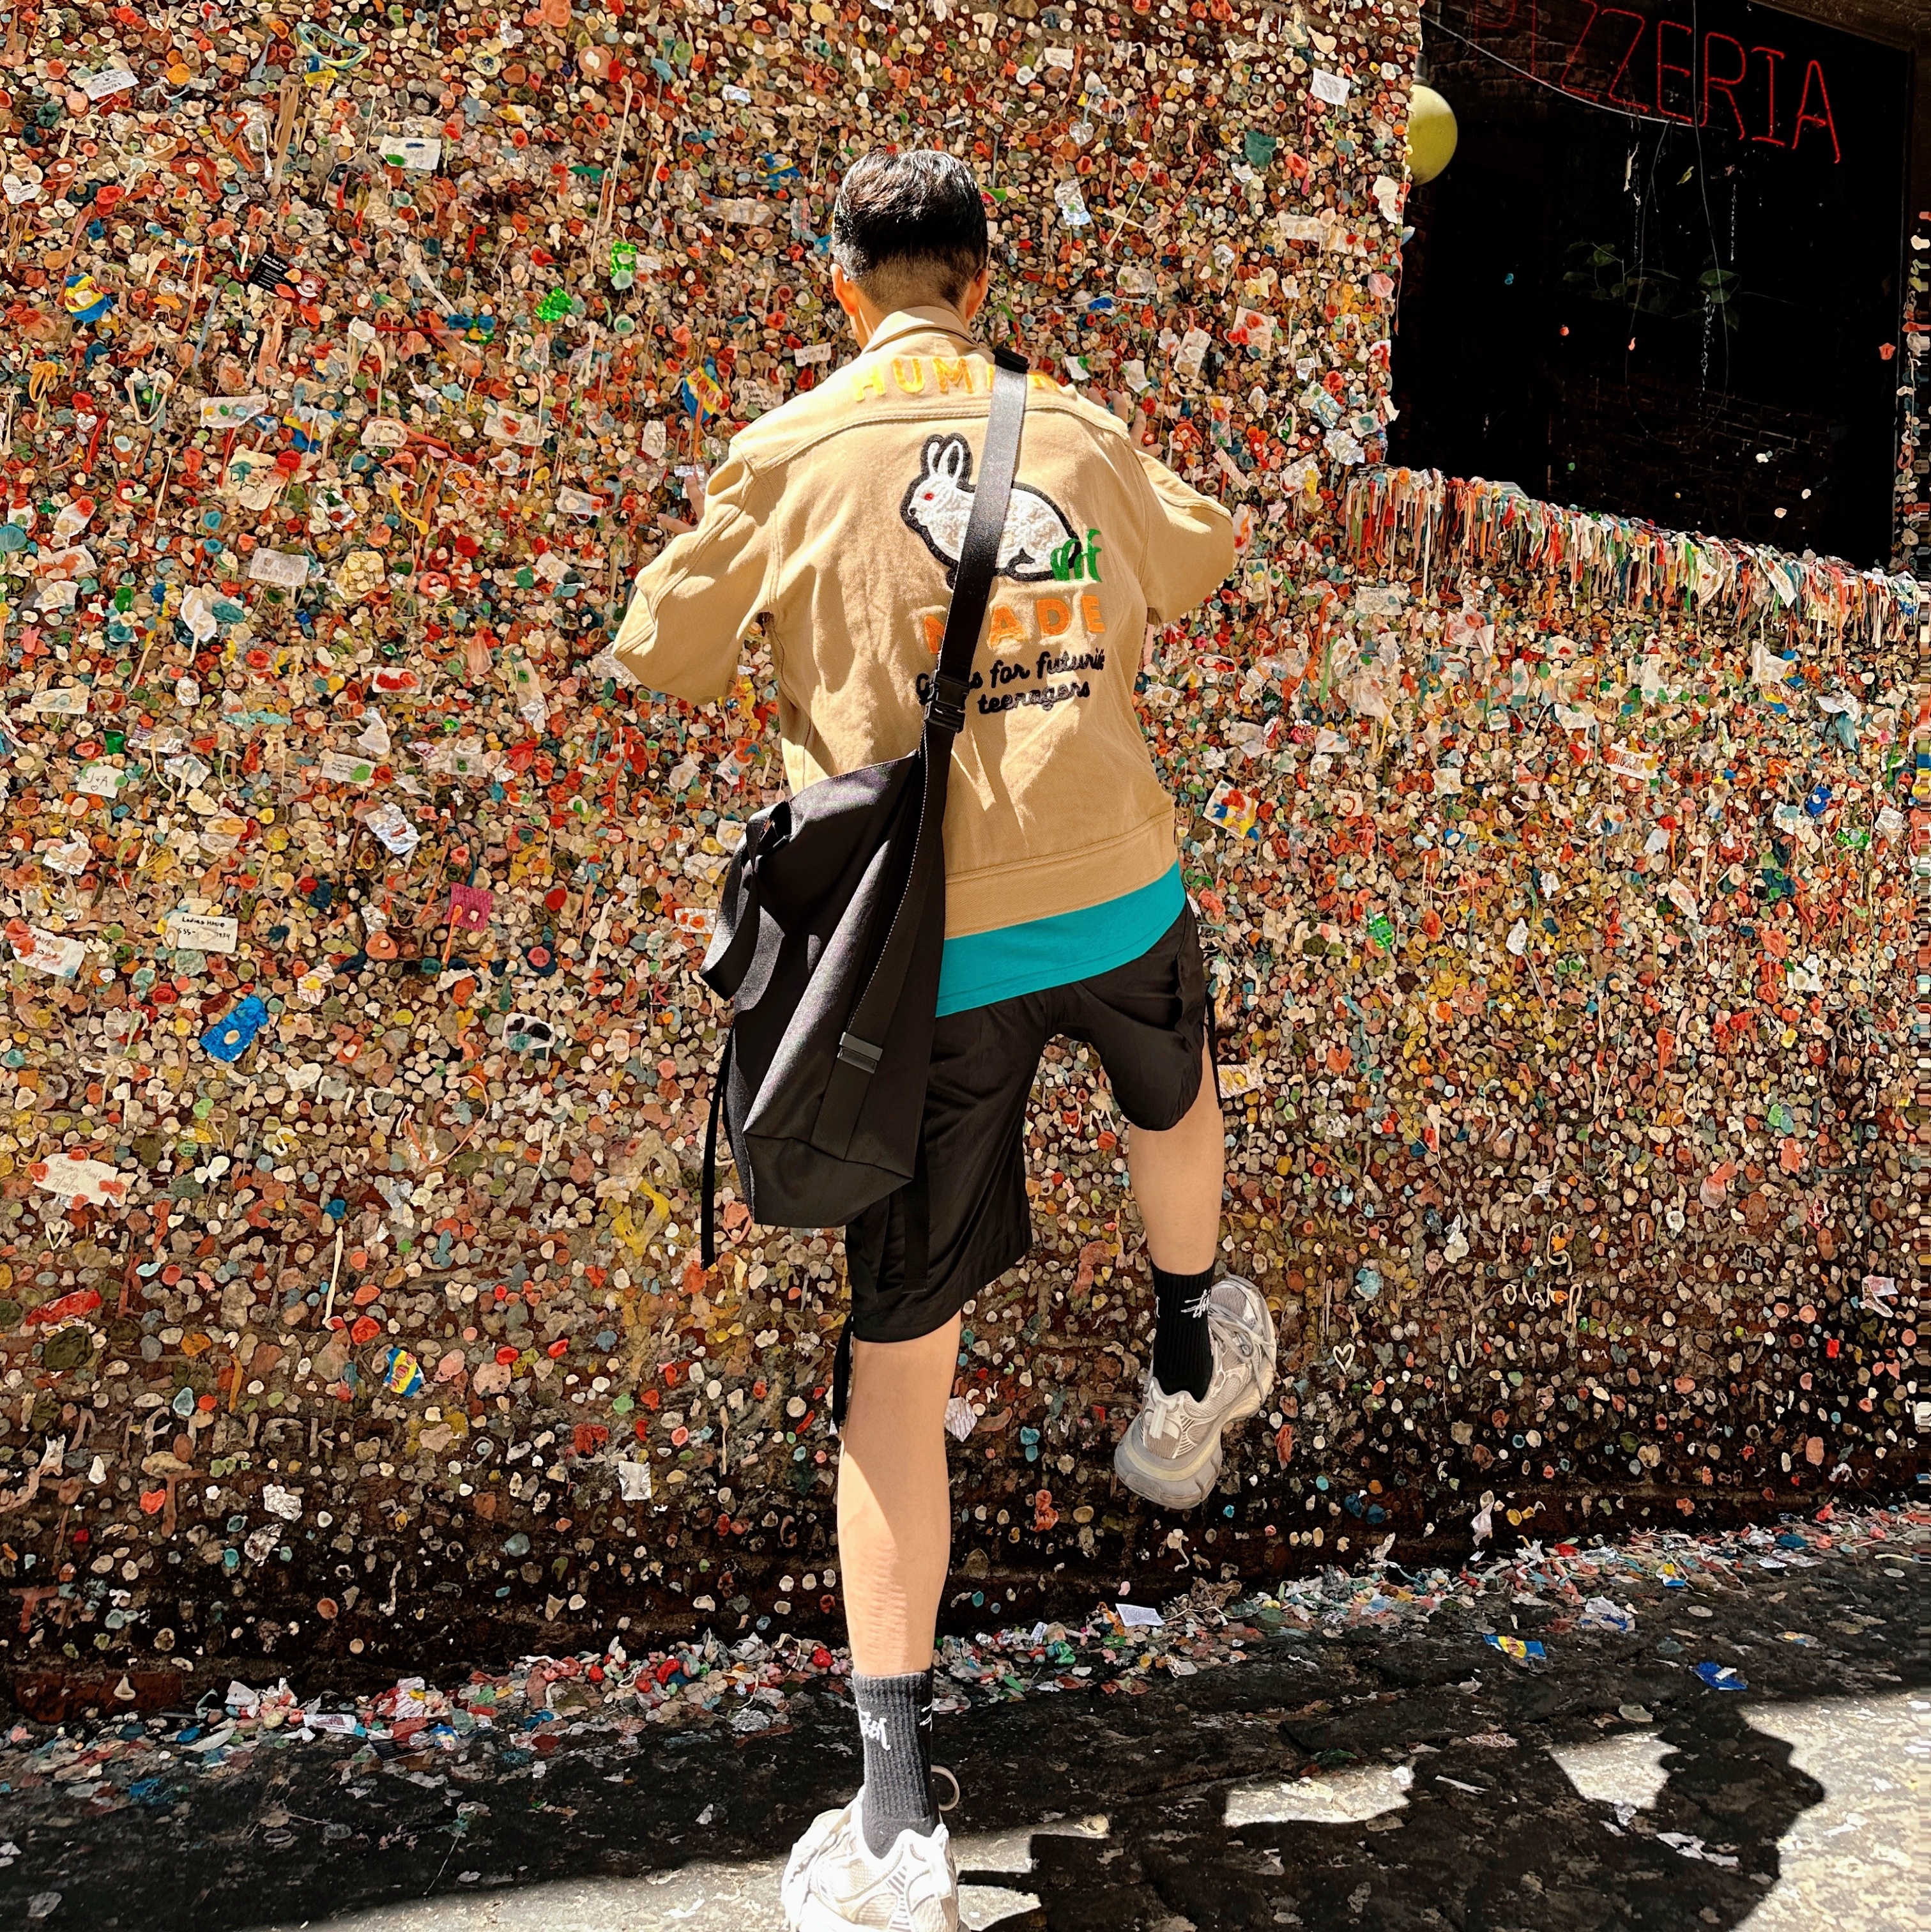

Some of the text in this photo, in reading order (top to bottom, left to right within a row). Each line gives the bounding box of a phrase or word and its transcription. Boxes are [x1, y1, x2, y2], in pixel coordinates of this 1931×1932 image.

[1471, 0, 1840, 164] PIZZERIA
[851, 356, 1062, 402] HUM
[989, 659, 1030, 689] for
[86, 772, 95, 783] J
[100, 776, 108, 787] A
[181, 916, 205, 925] Ladies
